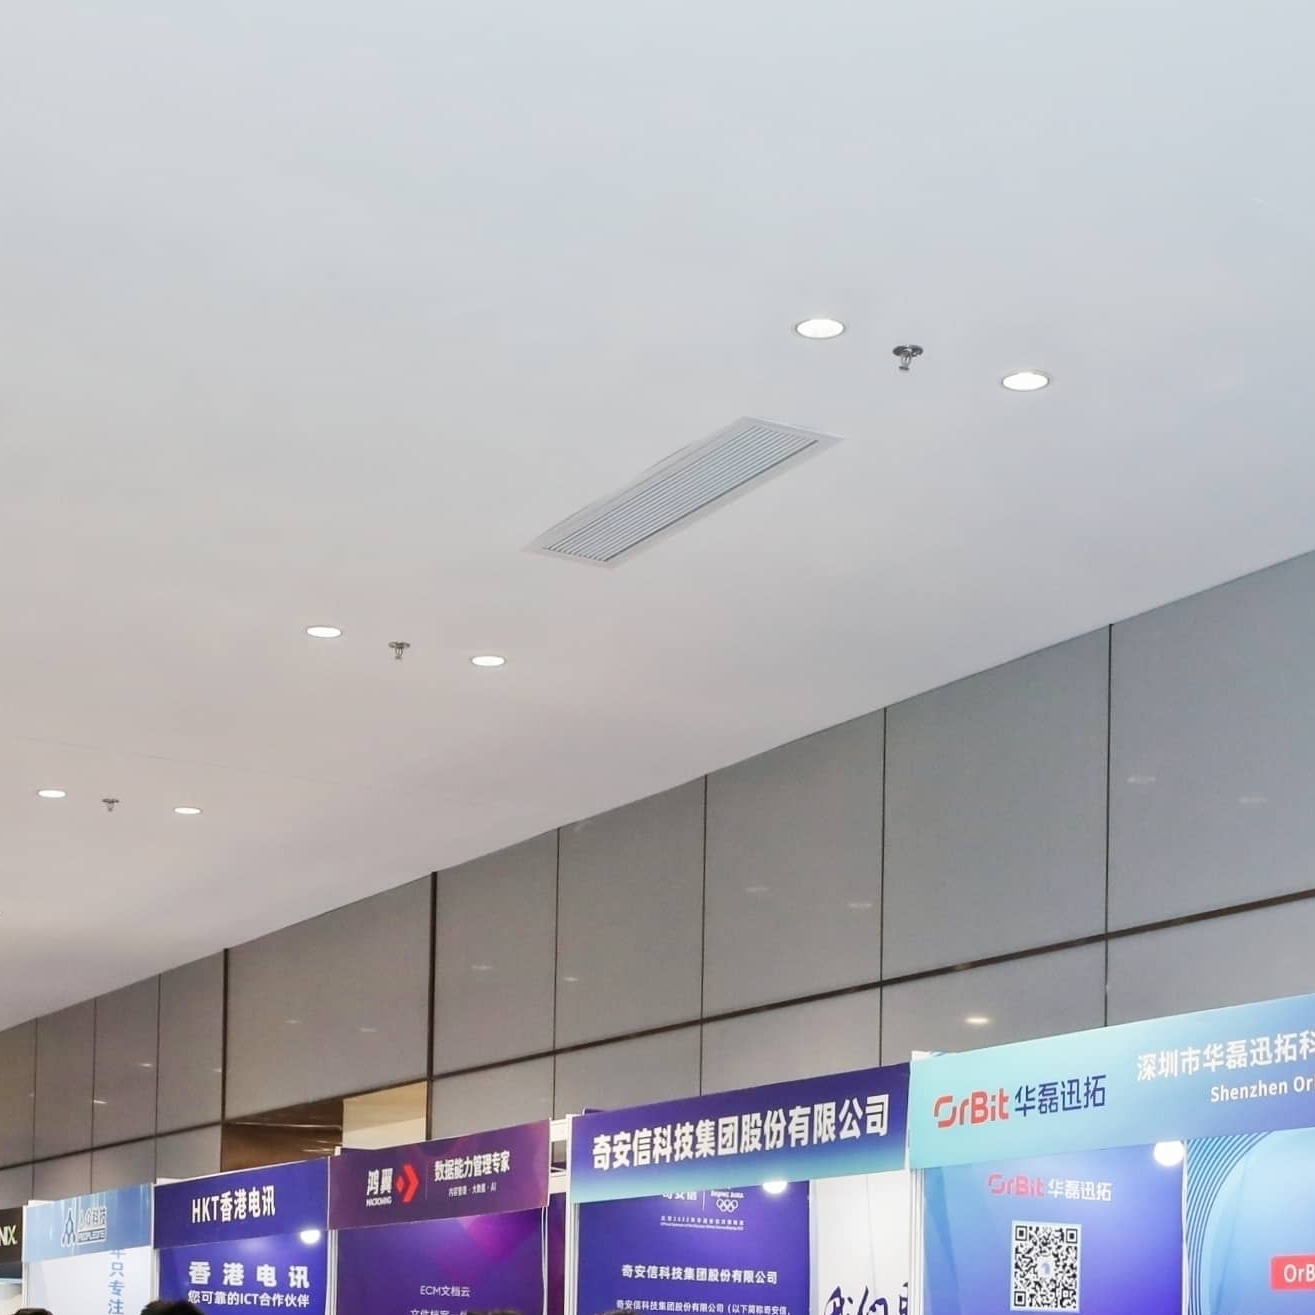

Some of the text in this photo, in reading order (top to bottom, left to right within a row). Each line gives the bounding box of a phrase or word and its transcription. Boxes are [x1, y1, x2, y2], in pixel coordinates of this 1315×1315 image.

[1014, 1074, 1107, 1118] 华磊迅拓
[1209, 1078, 1288, 1103] Shenzhen
[592, 1093, 890, 1172] 奇安信科技集团股份有限公司
[433, 1150, 511, 1183] 数据能力管理专家
[188, 1260, 310, 1289] 香港电讯
[621, 1264, 779, 1285] 奇安信科技集团股份有限公司
[187, 1290, 311, 1308] 您可靠的ICT合作伙伴
